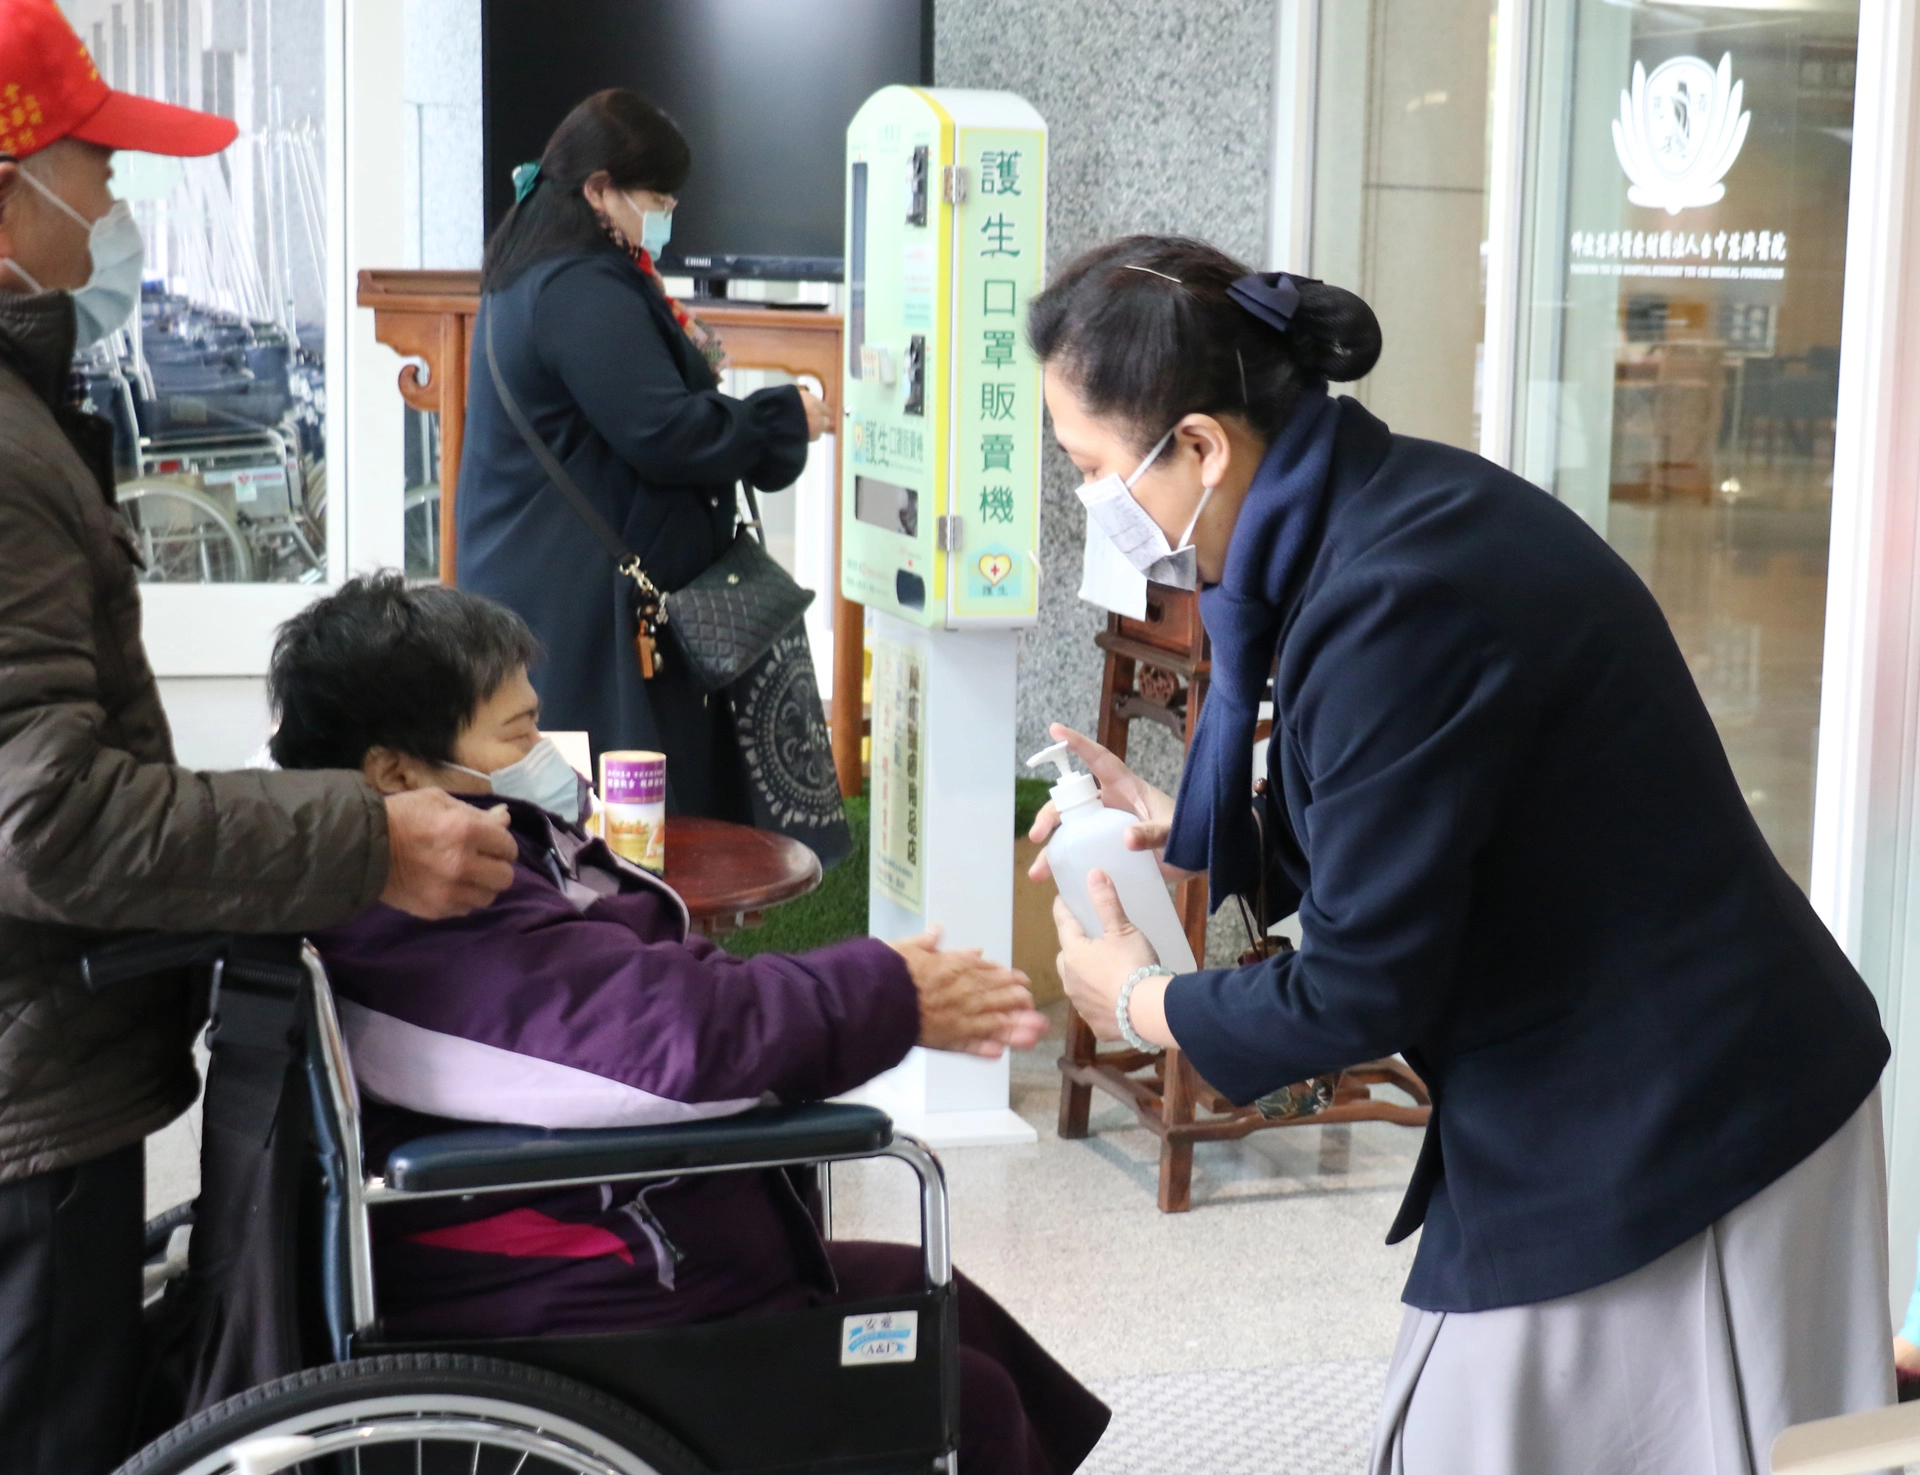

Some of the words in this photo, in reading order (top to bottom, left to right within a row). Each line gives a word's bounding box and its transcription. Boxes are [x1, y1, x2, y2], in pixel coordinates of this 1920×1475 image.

[980, 150, 1022, 524] 護生口罩販賣機
